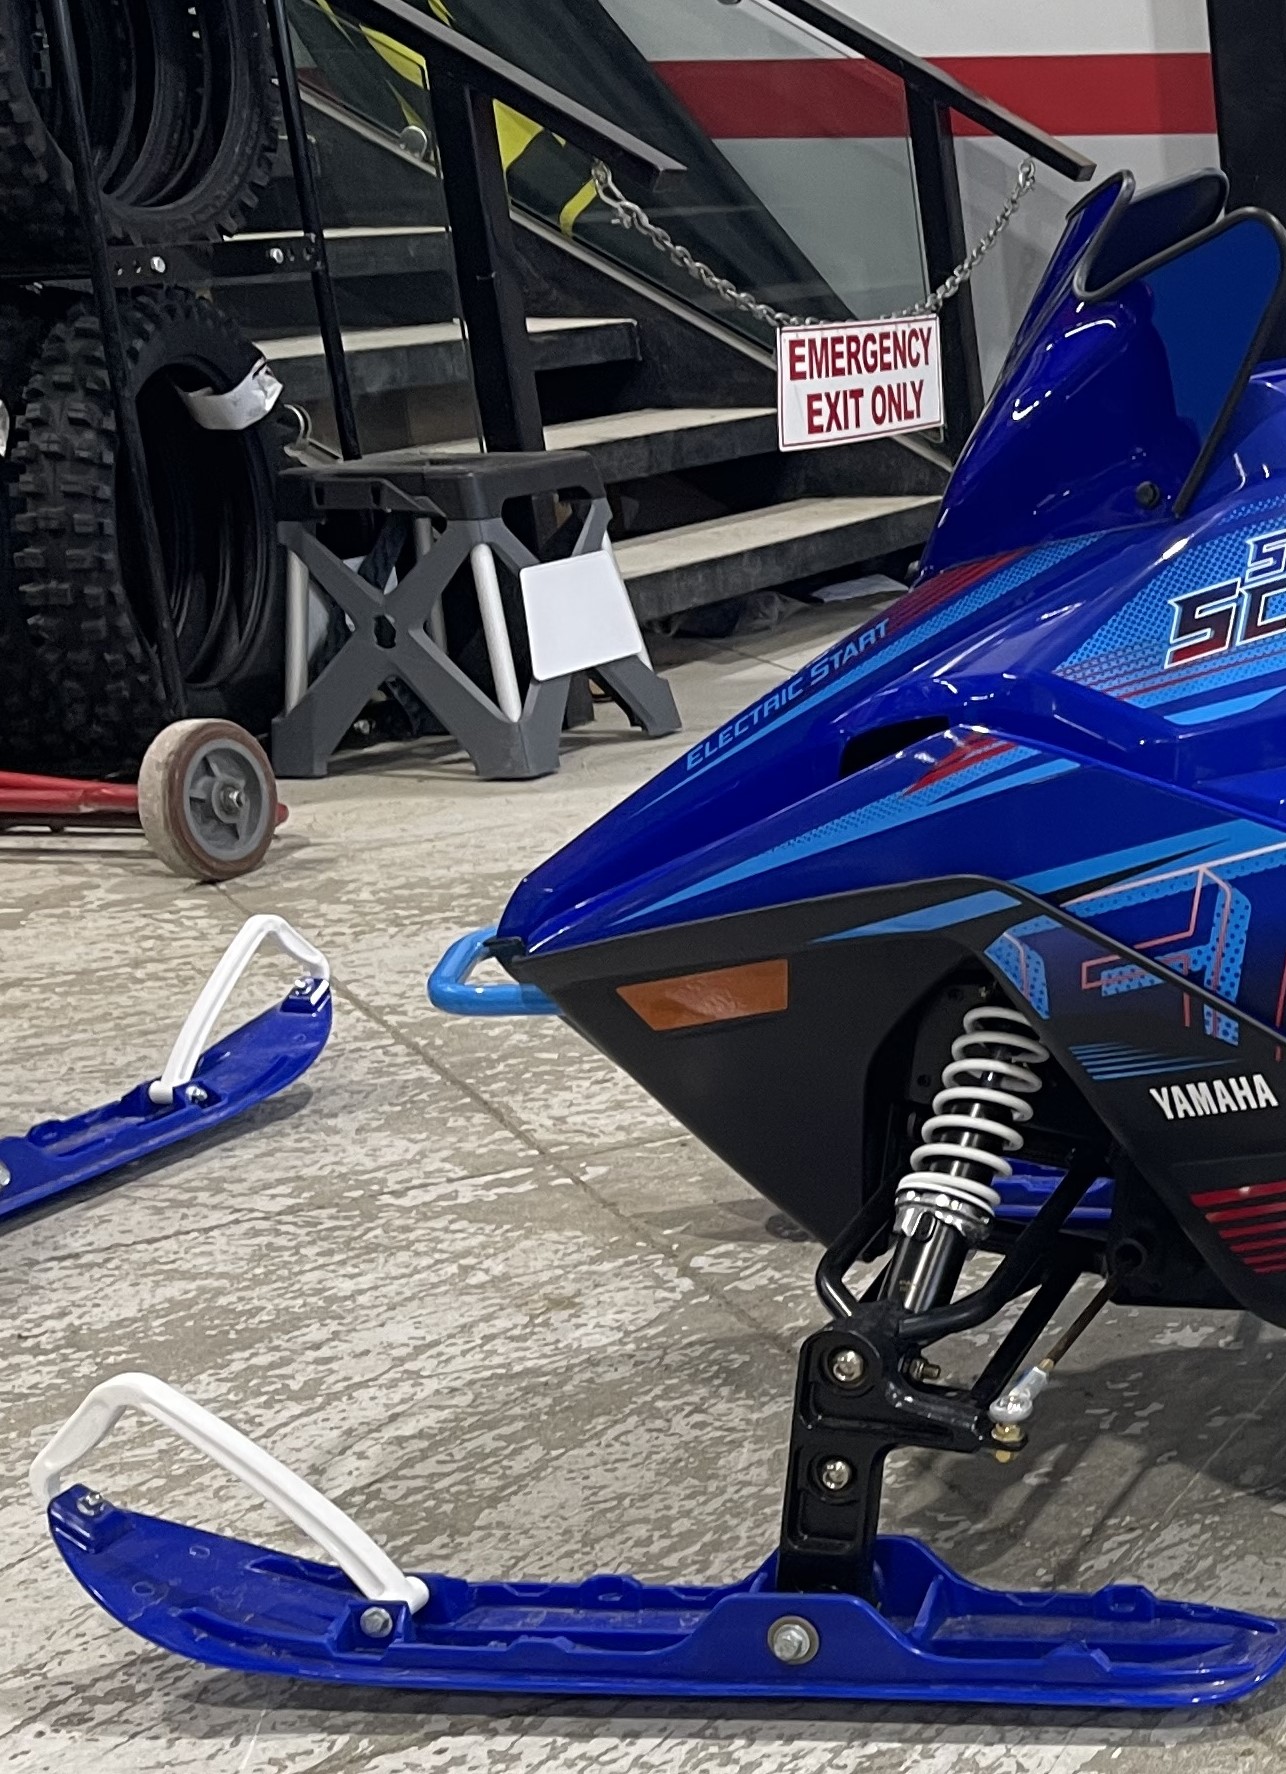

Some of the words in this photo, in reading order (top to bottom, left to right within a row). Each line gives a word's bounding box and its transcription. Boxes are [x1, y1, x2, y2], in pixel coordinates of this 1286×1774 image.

[788, 327, 932, 382] EMERGENCY
[806, 389, 864, 435] EXIT
[871, 379, 925, 425] ONLY
[686, 677, 804, 772] ELECTRIC
[809, 617, 890, 686] START
[1149, 1073, 1279, 1120] YAMAHA
